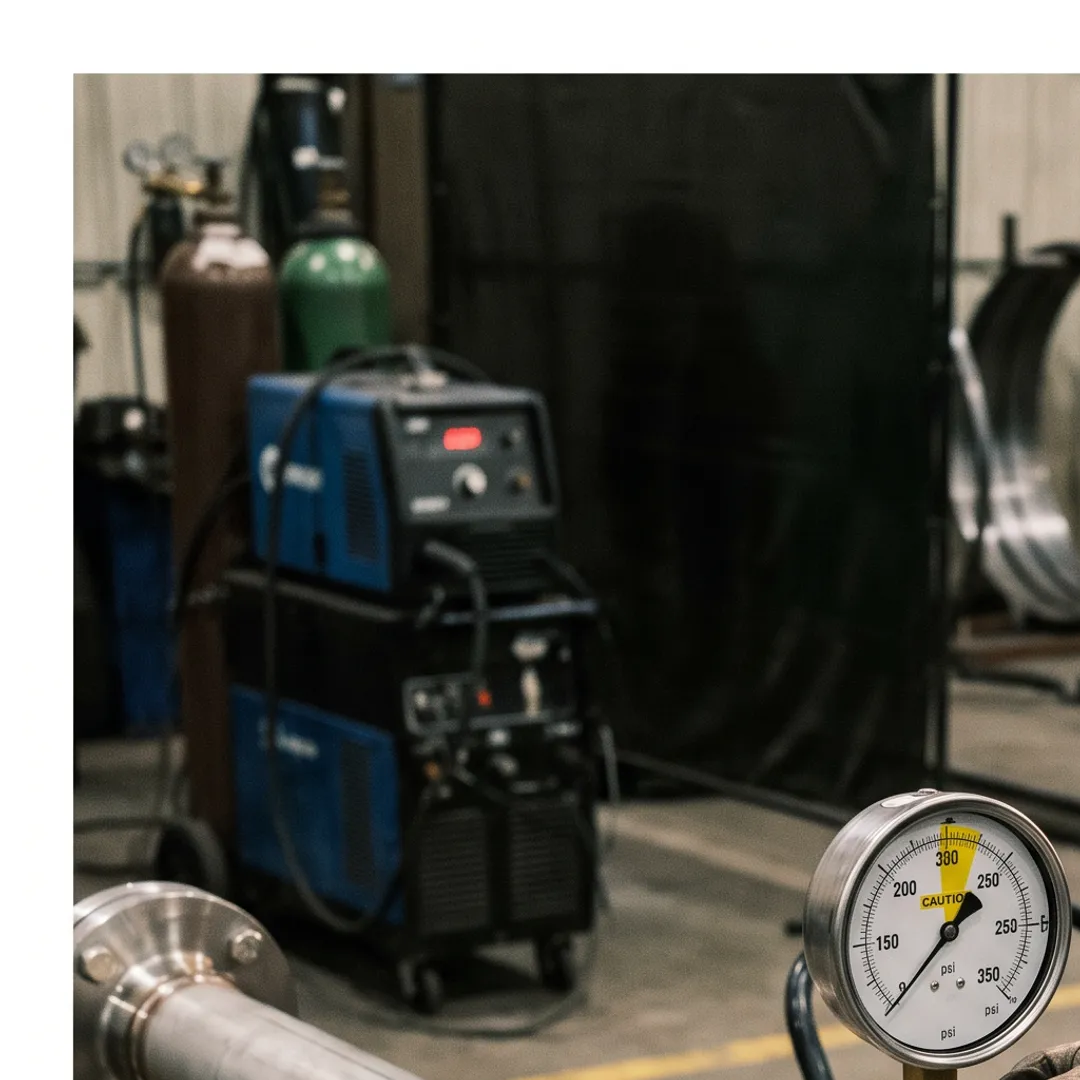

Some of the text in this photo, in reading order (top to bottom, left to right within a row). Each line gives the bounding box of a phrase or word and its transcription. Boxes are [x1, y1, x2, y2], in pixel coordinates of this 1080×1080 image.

[894, 880, 917, 898] 200
[977, 872, 999, 889] 250
[922, 893, 964, 908] CAUTIO
[995, 918, 1018, 936] 250
[876, 933, 899, 951] 150
[941, 961, 956, 976] psi
[977, 966, 1000, 984] 350
[985, 1003, 999, 1017] psi
[941, 1026, 956, 1041] psi
